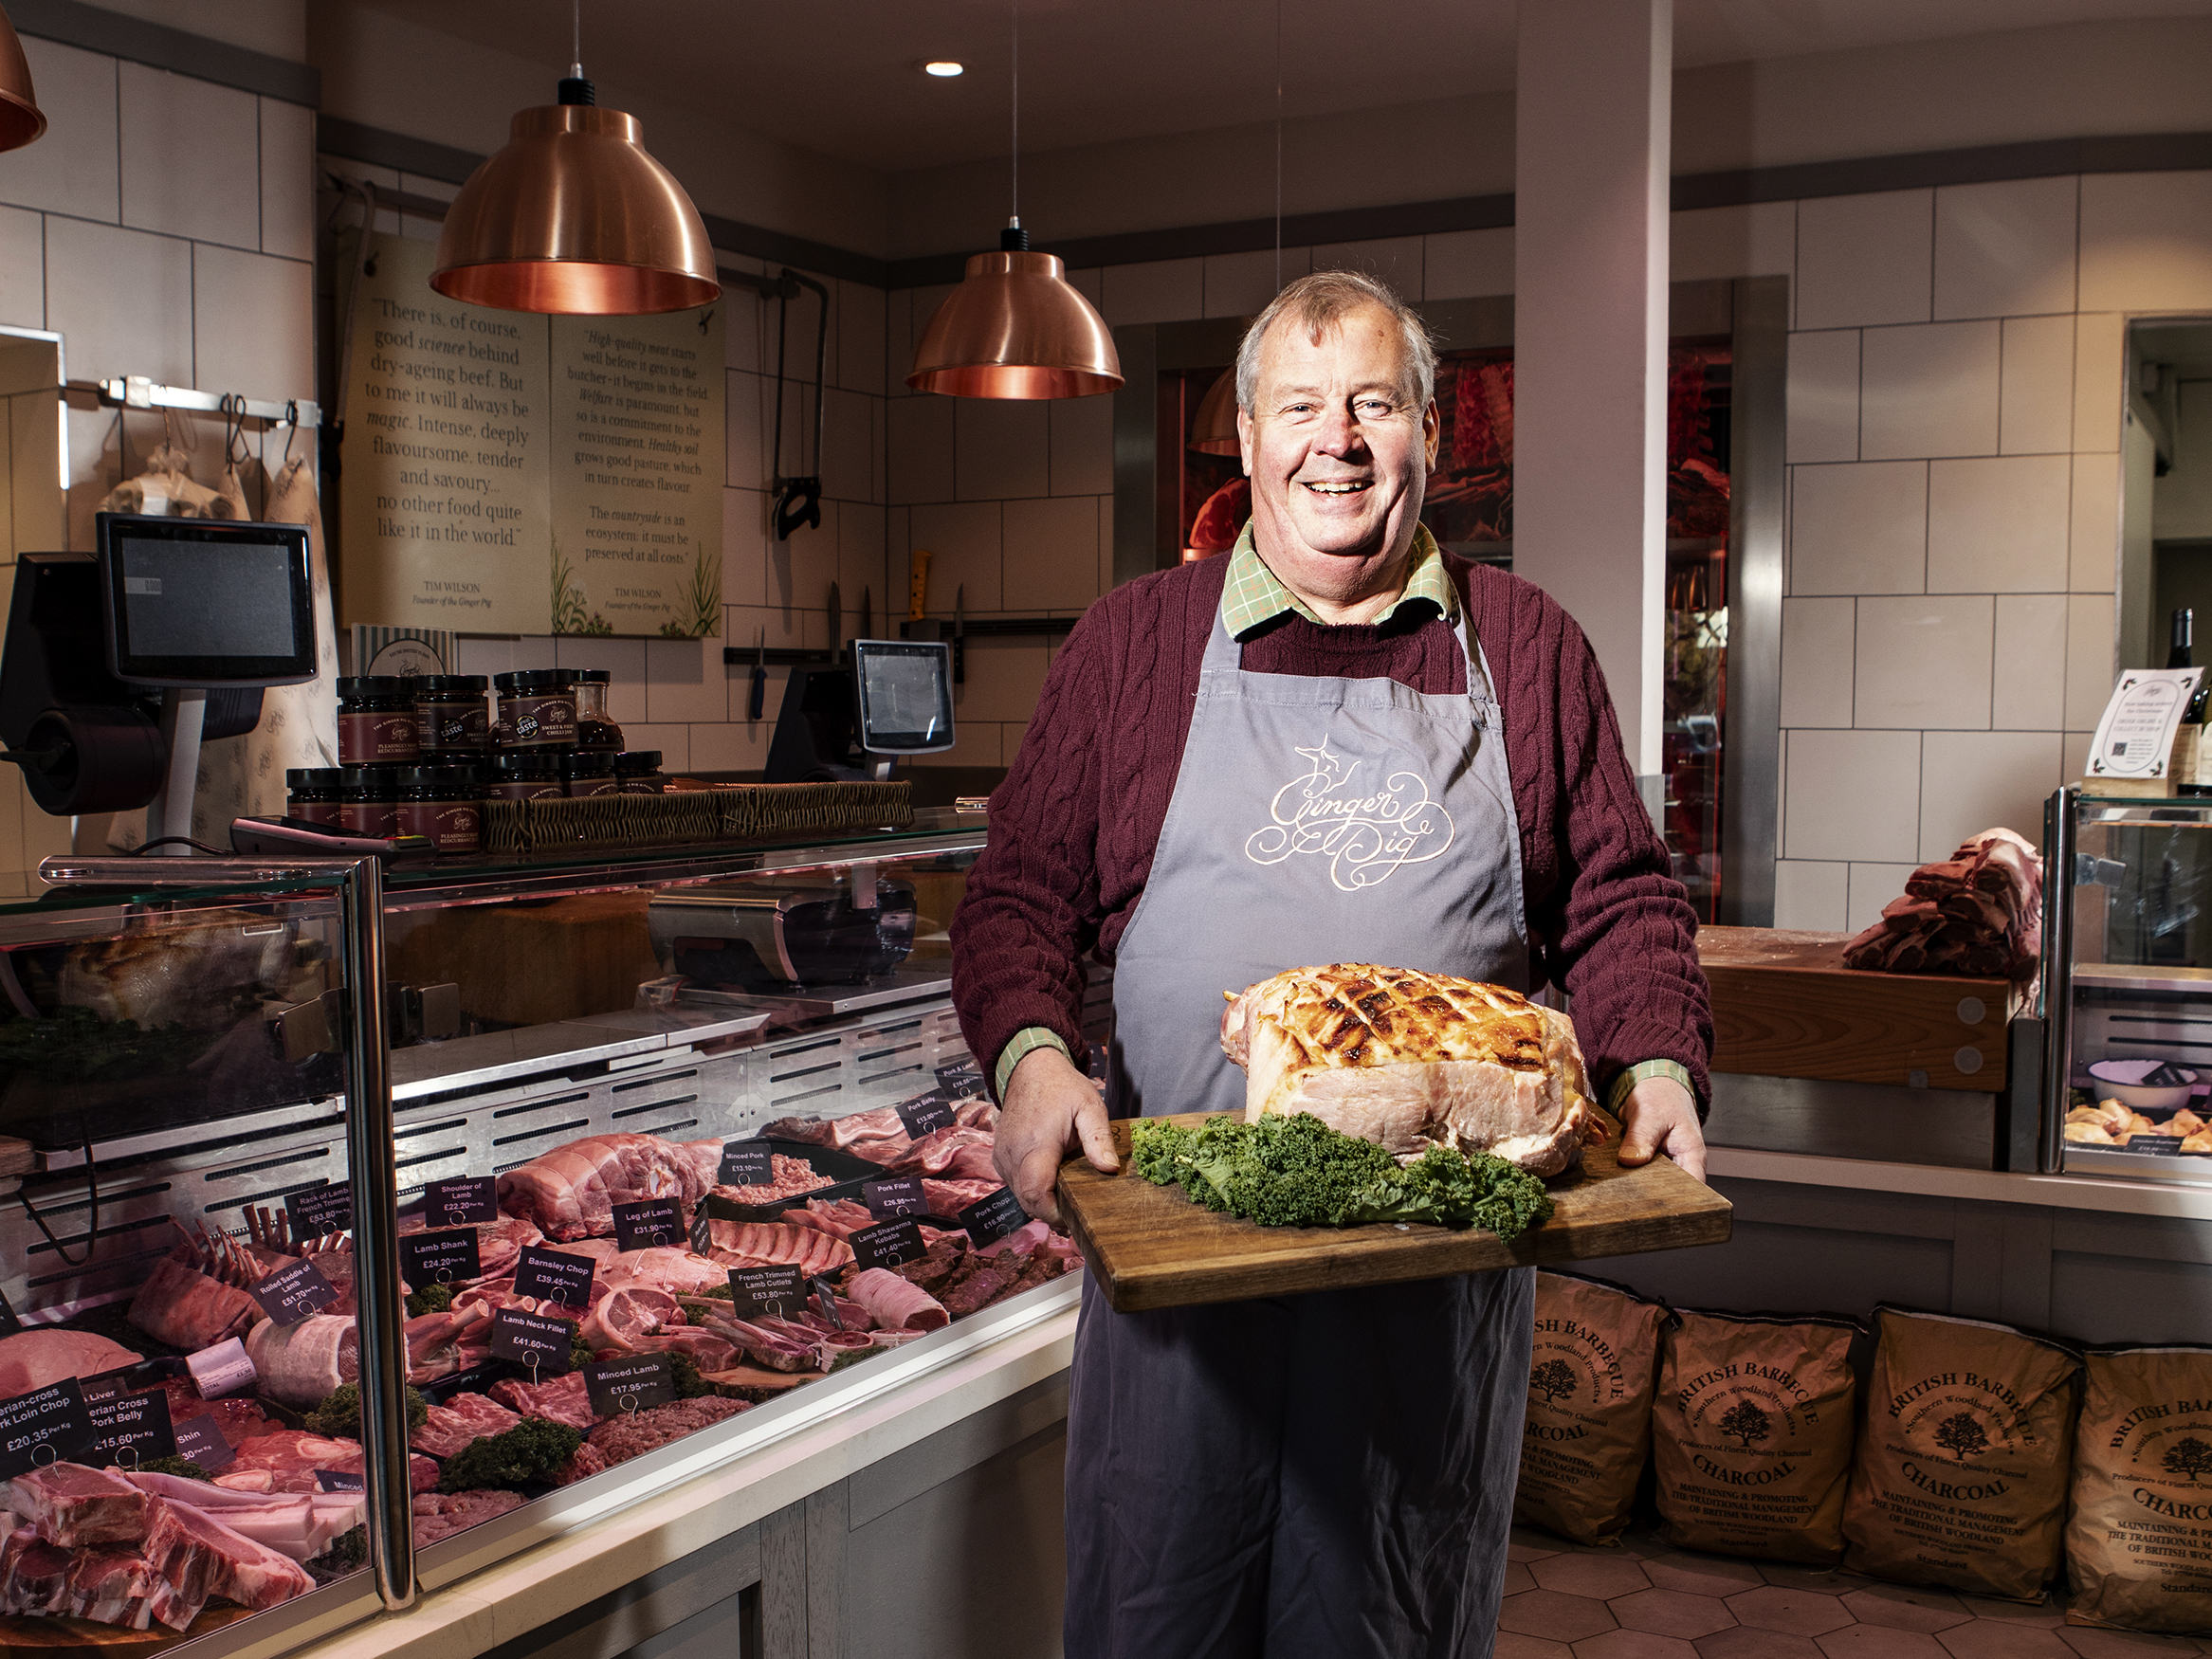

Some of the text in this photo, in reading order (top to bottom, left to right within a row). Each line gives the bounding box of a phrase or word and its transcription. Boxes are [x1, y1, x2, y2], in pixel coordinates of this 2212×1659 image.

[450, 313, 466, 330] of
[375, 330, 520, 365] good science behind
[371, 354, 455, 384] dry-ageing
[500, 371, 523, 392] But
[365, 382, 529, 418] to me it will always be
[481, 425, 529, 447] deeply
[477, 450, 524, 469] tender
[575, 451, 604, 465] grows
[606, 455, 631, 468] good
[673, 461, 702, 475] which
[399, 469, 429, 485] and
[585, 472, 594, 483] in
[597, 473, 619, 485] turn
[620, 476, 654, 489] creates
[376, 495, 521, 523] no other food quite
[611, 511, 662, 526] countryside
[664, 515, 671, 525] is
[673, 516, 686, 526] an
[377, 518, 406, 538] like
[411, 522, 421, 539] it
[426, 521, 440, 540] in
[445, 523, 468, 542] the
[642, 530, 649, 542] it
[651, 532, 674, 545] must
[677, 532, 688, 545] be
[585, 547, 633, 561] preserved
[635, 551, 646, 561] at
[647, 548, 659, 562] all
[423, 580, 481, 593] TIM WILSON
[614, 588, 662, 598] TIM WILSON
[441, 724, 464, 738] taste
[516, 719, 539, 735] taste
[299, 1195, 319, 1205] Rack
[328, 1188, 349, 1198] Lamb
[441, 1184, 473, 1194] Shoulder
[297, 1195, 351, 1213] French Trimme
[444, 1202, 470, 1211] £22.20
[975, 1196, 1011, 1219] Pork Chop
[642, 1210, 650, 1218] of
[651, 1208, 673, 1217] Lamb
[633, 1224, 660, 1234] £31.90
[857, 1220, 912, 1243] Lamb Shawarma
[414, 1239, 468, 1253] Lamb Shank
[874, 1232, 901, 1245] Kebabs
[873, 1243, 899, 1257] £41.40
[423, 1257, 450, 1268] £24.20
[527, 1256, 590, 1276] Barnsley Chop
[259, 1264, 311, 1295] Rolled Saddle of
[536, 1274, 564, 1286] £39.45
[738, 1269, 796, 1282] French Trimmed
[744, 1279, 793, 1289] Lamb Cutlets
[281, 1280, 302, 1293] Lamb
[752, 1290, 778, 1300] £53.80
[282, 1290, 307, 1306] £51.70
[503, 1314, 567, 1335] Lamb Neck Fillet
[513, 1336, 541, 1349] £41.60
[1563, 1320, 1624, 1398] BARBECUE
[596, 1363, 660, 1380] Minced Lamb
[89, 1390, 116, 1401] Liver
[202, 1382, 220, 1393] TOTAL
[610, 1382, 642, 1395] £17.95
[1677, 1361, 1819, 1426] BRITISH BARBECUE
[1888, 1372, 1957, 1418] BRITISH
[0, 1388, 60, 1416] erian-cross
[12, 1409, 38, 1424] Loin
[40, 1397, 70, 1413] Chop
[89, 1397, 149, 1417] erian Cross
[1693, 1385, 1796, 1431] Southern Woodland Products
[117, 1410, 143, 1423] Belly
[1526, 1422, 1589, 1441] RCOAL
[2110, 1404, 2171, 1449] BRITISH
[7, 1422, 72, 1452] £20.35 Per Kg
[176, 1431, 202, 1445] Shin
[1692, 1453, 1797, 1486] CHARCOAL
[1901, 1461, 2009, 1501] CHARCOAL
[1679, 1482, 1808, 1504] MAINTAINING & PROMOTING
[1672, 1490, 1819, 1514] THE TRADITIONAL MANAGEMENT
[2133, 1487, 2212, 1521] CHARC
[1689, 1504, 1798, 1524] OF BRITISH WOODLAND
[1719, 1538, 1768, 1548] Standard
[1916, 1554, 1967, 1570] Standard
